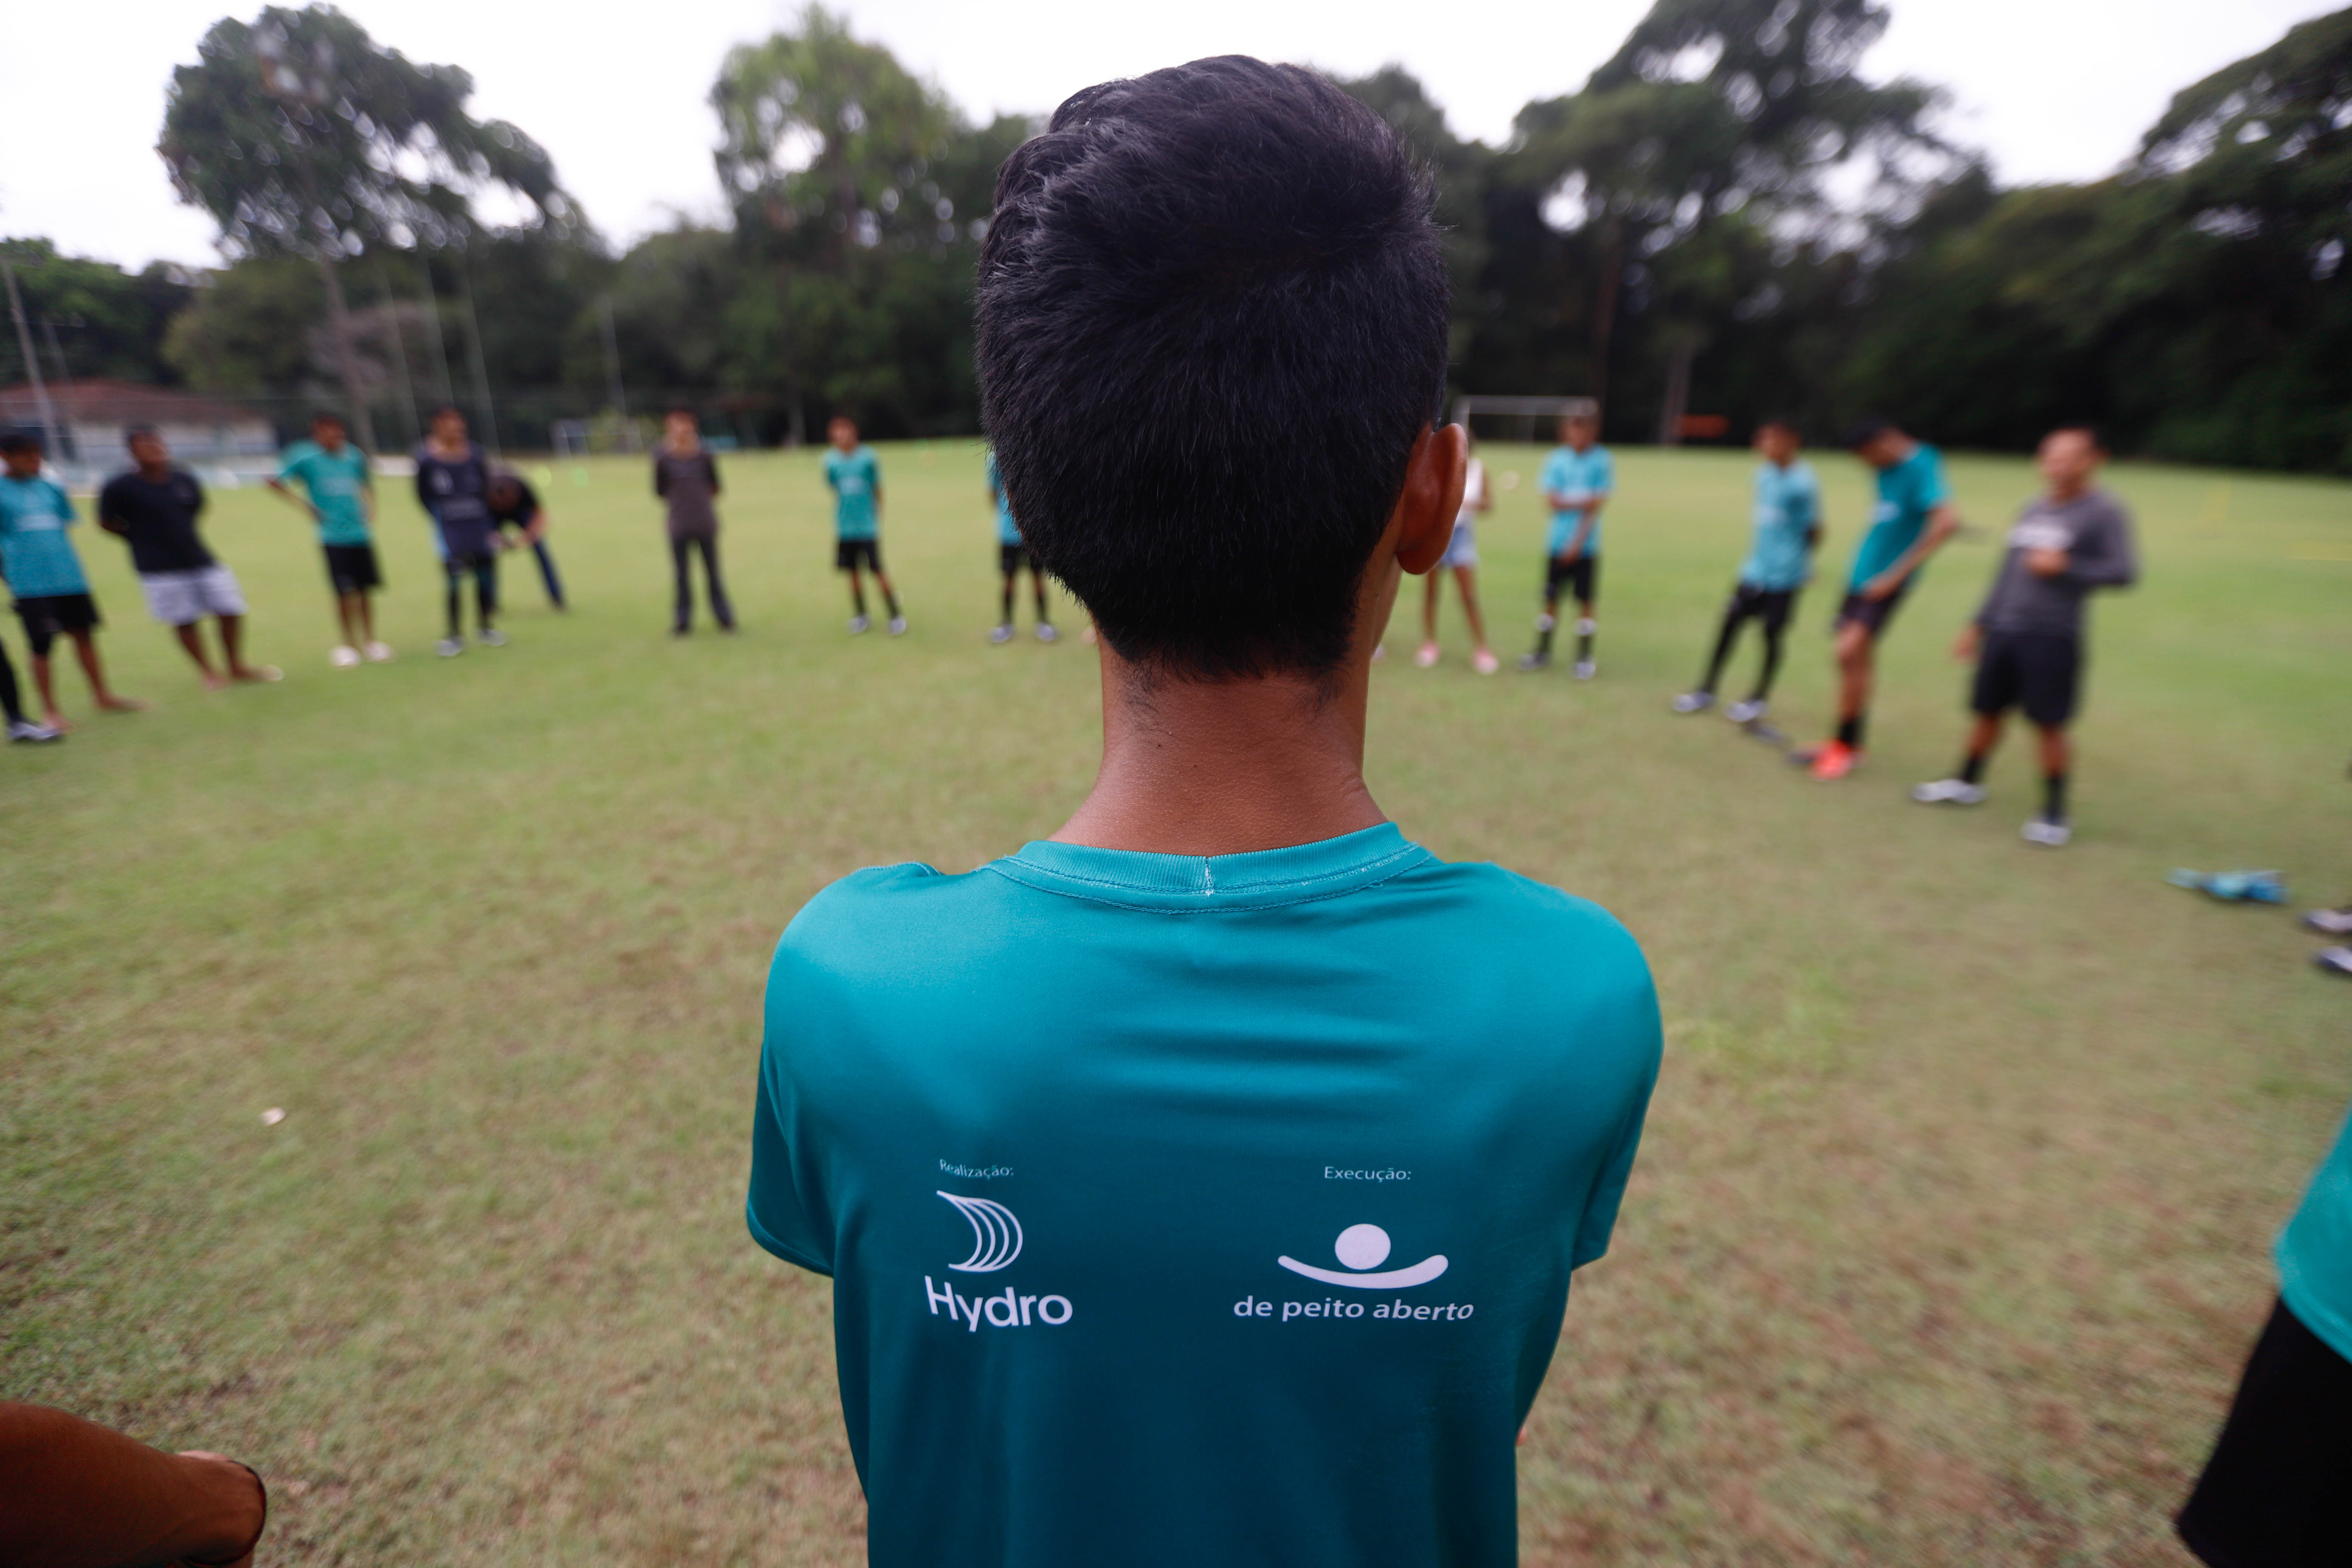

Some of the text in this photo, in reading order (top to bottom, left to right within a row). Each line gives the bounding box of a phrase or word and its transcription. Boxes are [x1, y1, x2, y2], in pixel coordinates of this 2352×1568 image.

[939, 1159, 1014, 1180] Realização:
[1325, 1166, 1411, 1182] Execução:
[924, 1275, 1073, 1332] Hydro
[1234, 1295, 1474, 1322] de peito aberto
